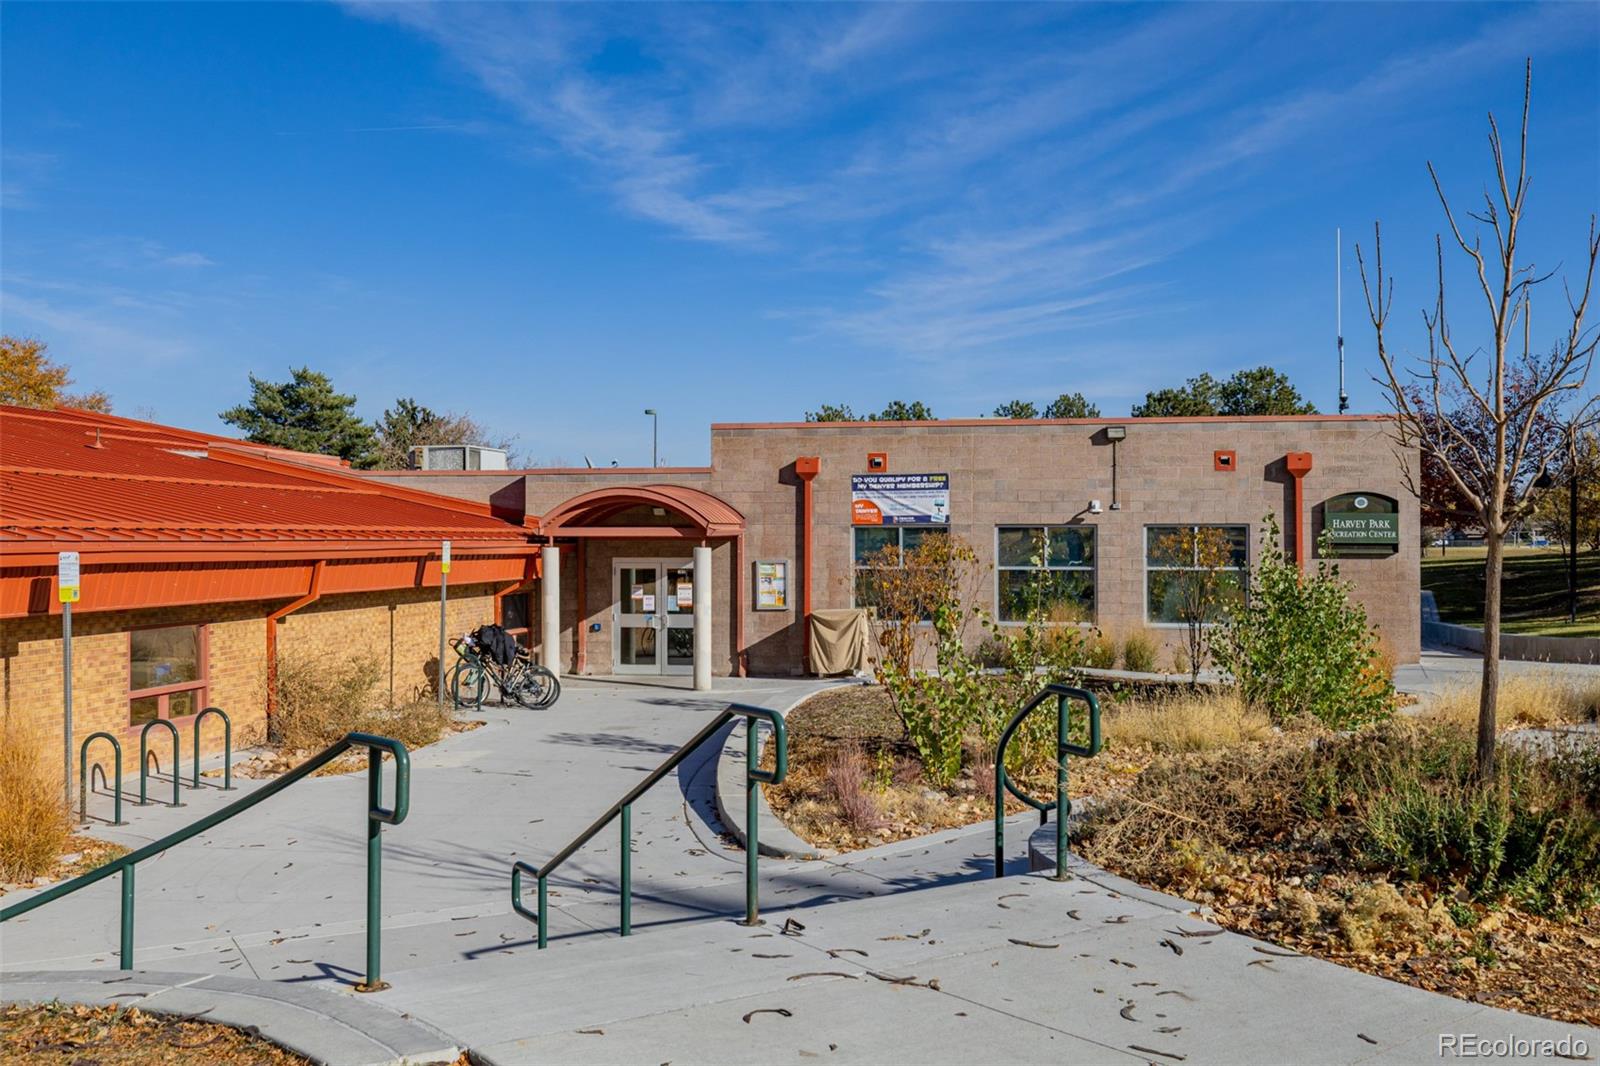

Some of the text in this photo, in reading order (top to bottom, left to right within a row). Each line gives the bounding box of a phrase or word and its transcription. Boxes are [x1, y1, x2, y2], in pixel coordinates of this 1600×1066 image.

[1333, 519, 1391, 529] HARVEY PARK
[1368, 530, 1397, 538] CENTER
